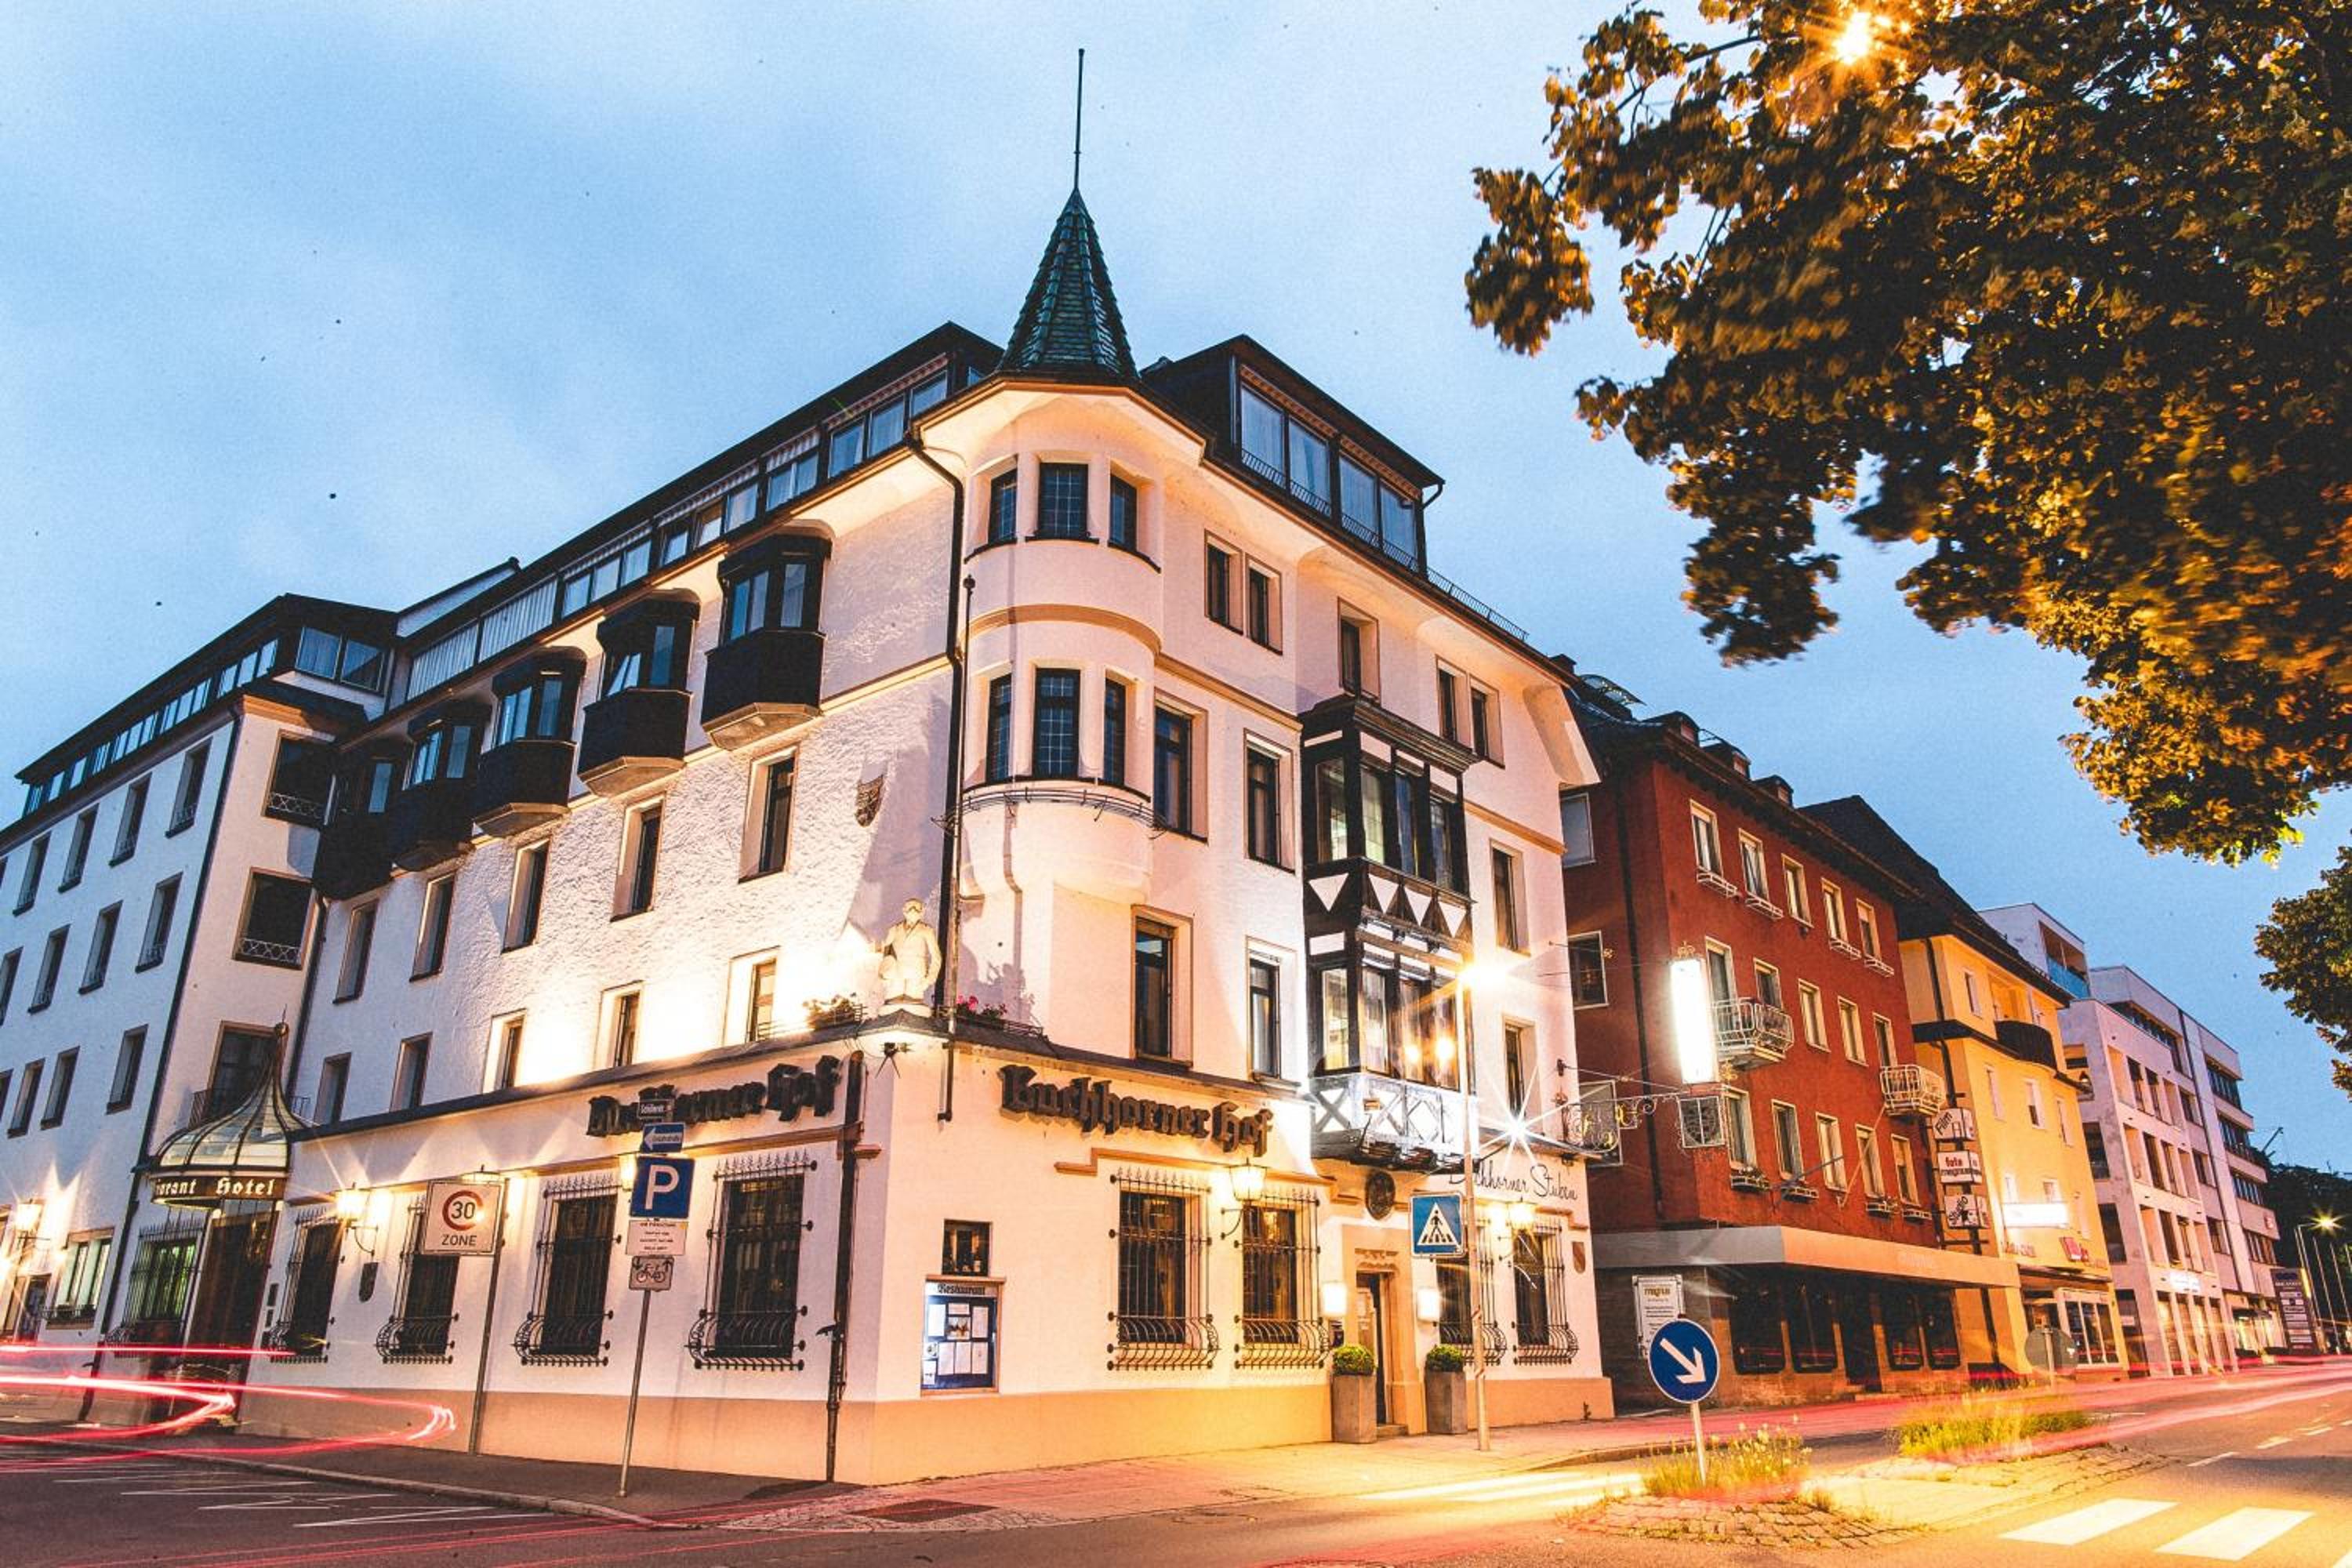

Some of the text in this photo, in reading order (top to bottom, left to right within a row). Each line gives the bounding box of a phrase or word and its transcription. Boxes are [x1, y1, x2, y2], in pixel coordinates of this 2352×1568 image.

[997, 1064, 1273, 1157] Buchhorner Hof
[216, 1177, 275, 1196] Hotel
[645, 1164, 680, 1210] P
[451, 1200, 476, 1219] 30
[441, 1234, 477, 1246] ZONE
